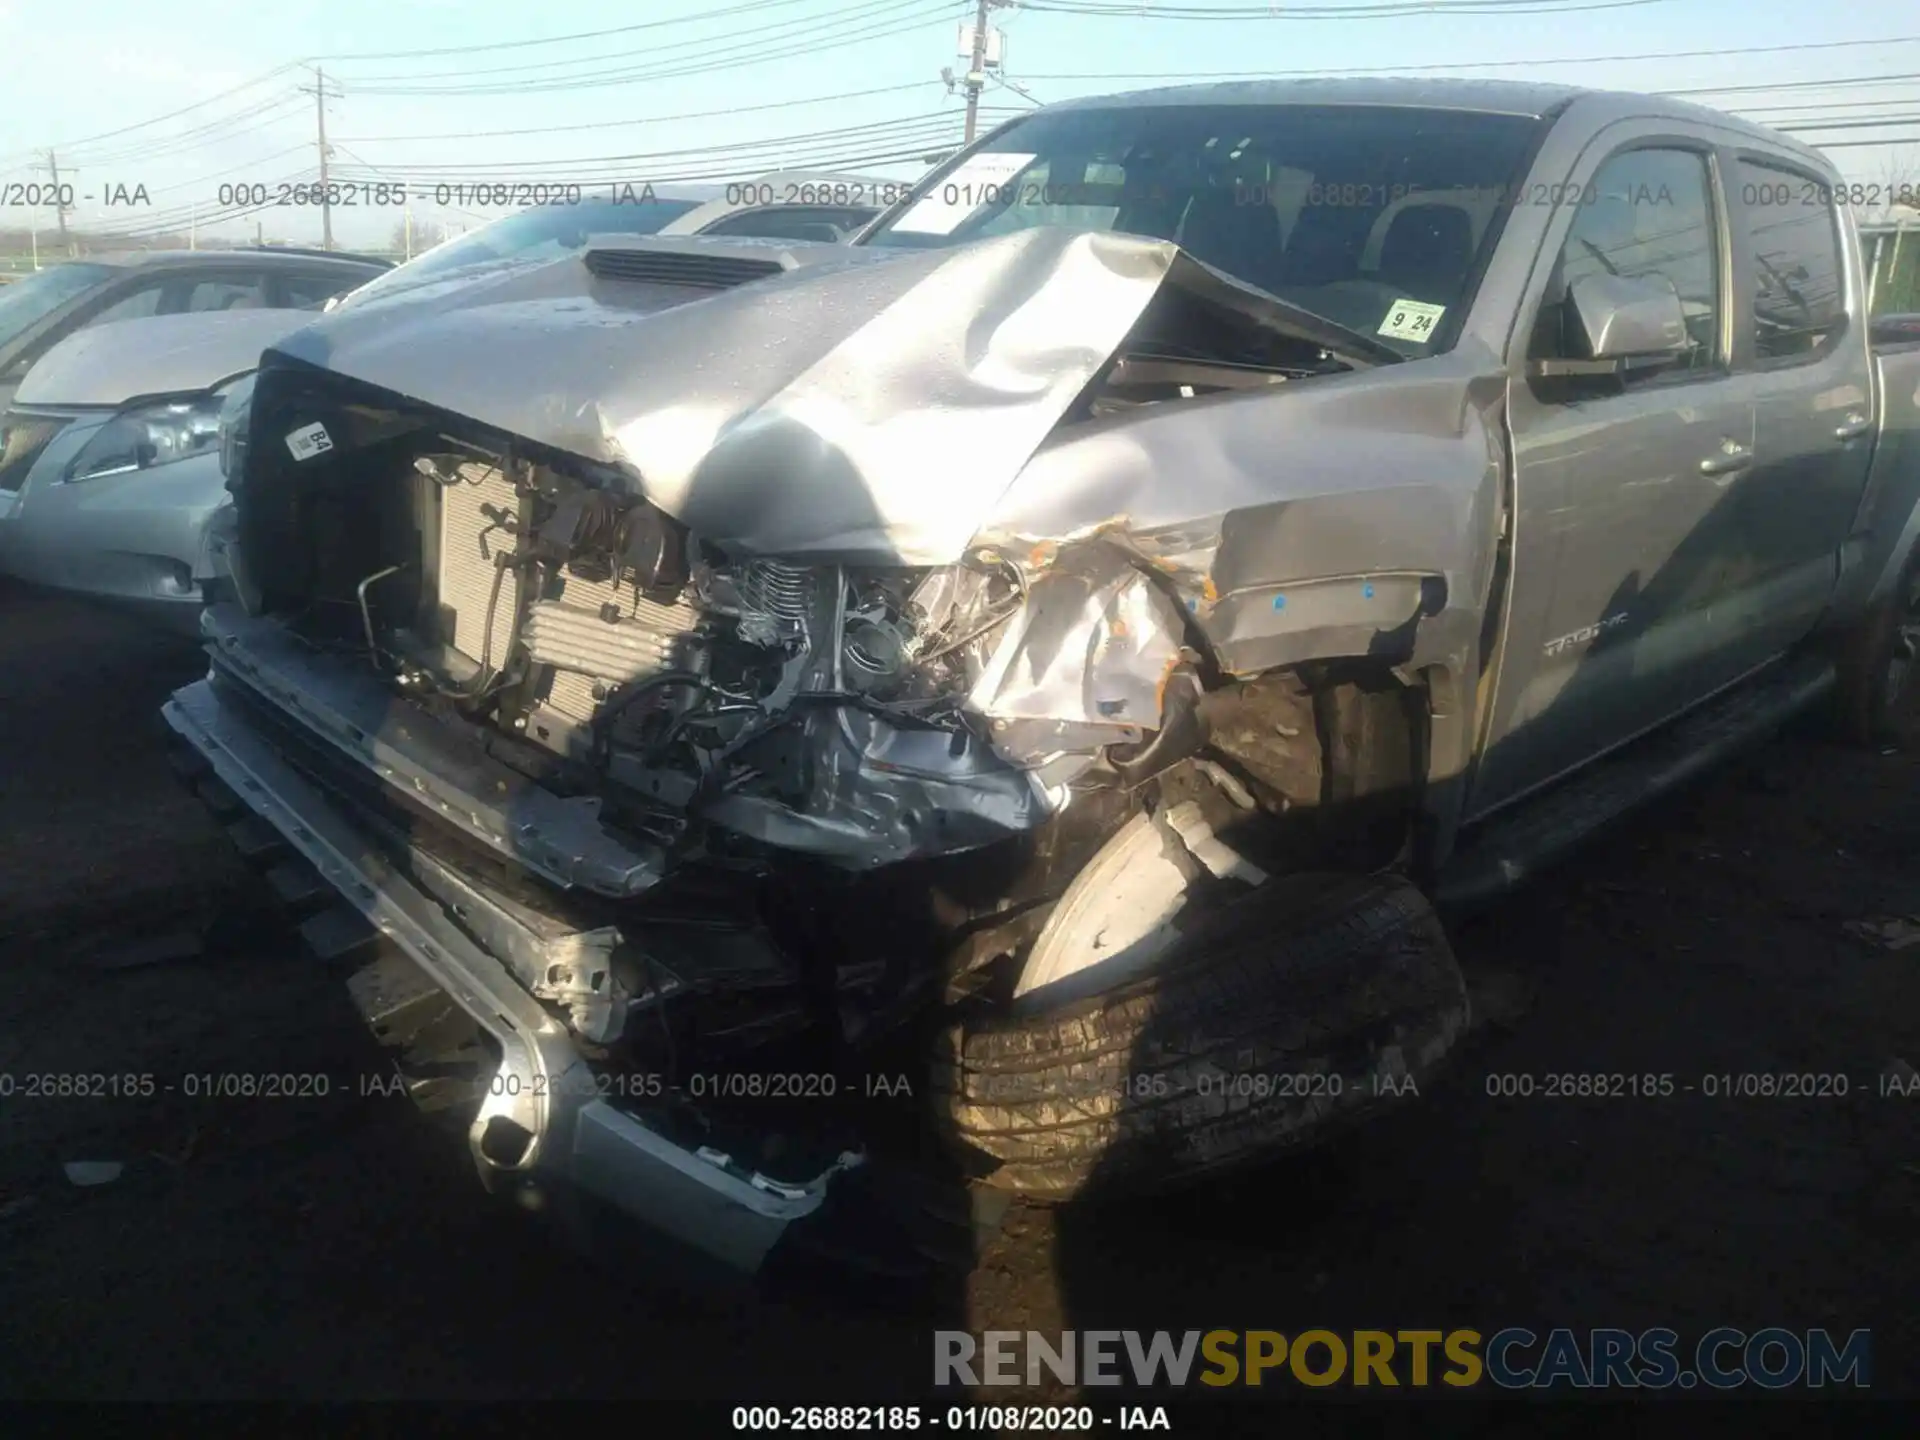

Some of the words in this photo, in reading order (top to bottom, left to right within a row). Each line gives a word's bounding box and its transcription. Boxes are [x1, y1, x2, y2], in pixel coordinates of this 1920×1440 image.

[1392, 313, 1405, 327] 9
[1411, 315, 1433, 332] 24
[309, 430, 332, 450] B4
